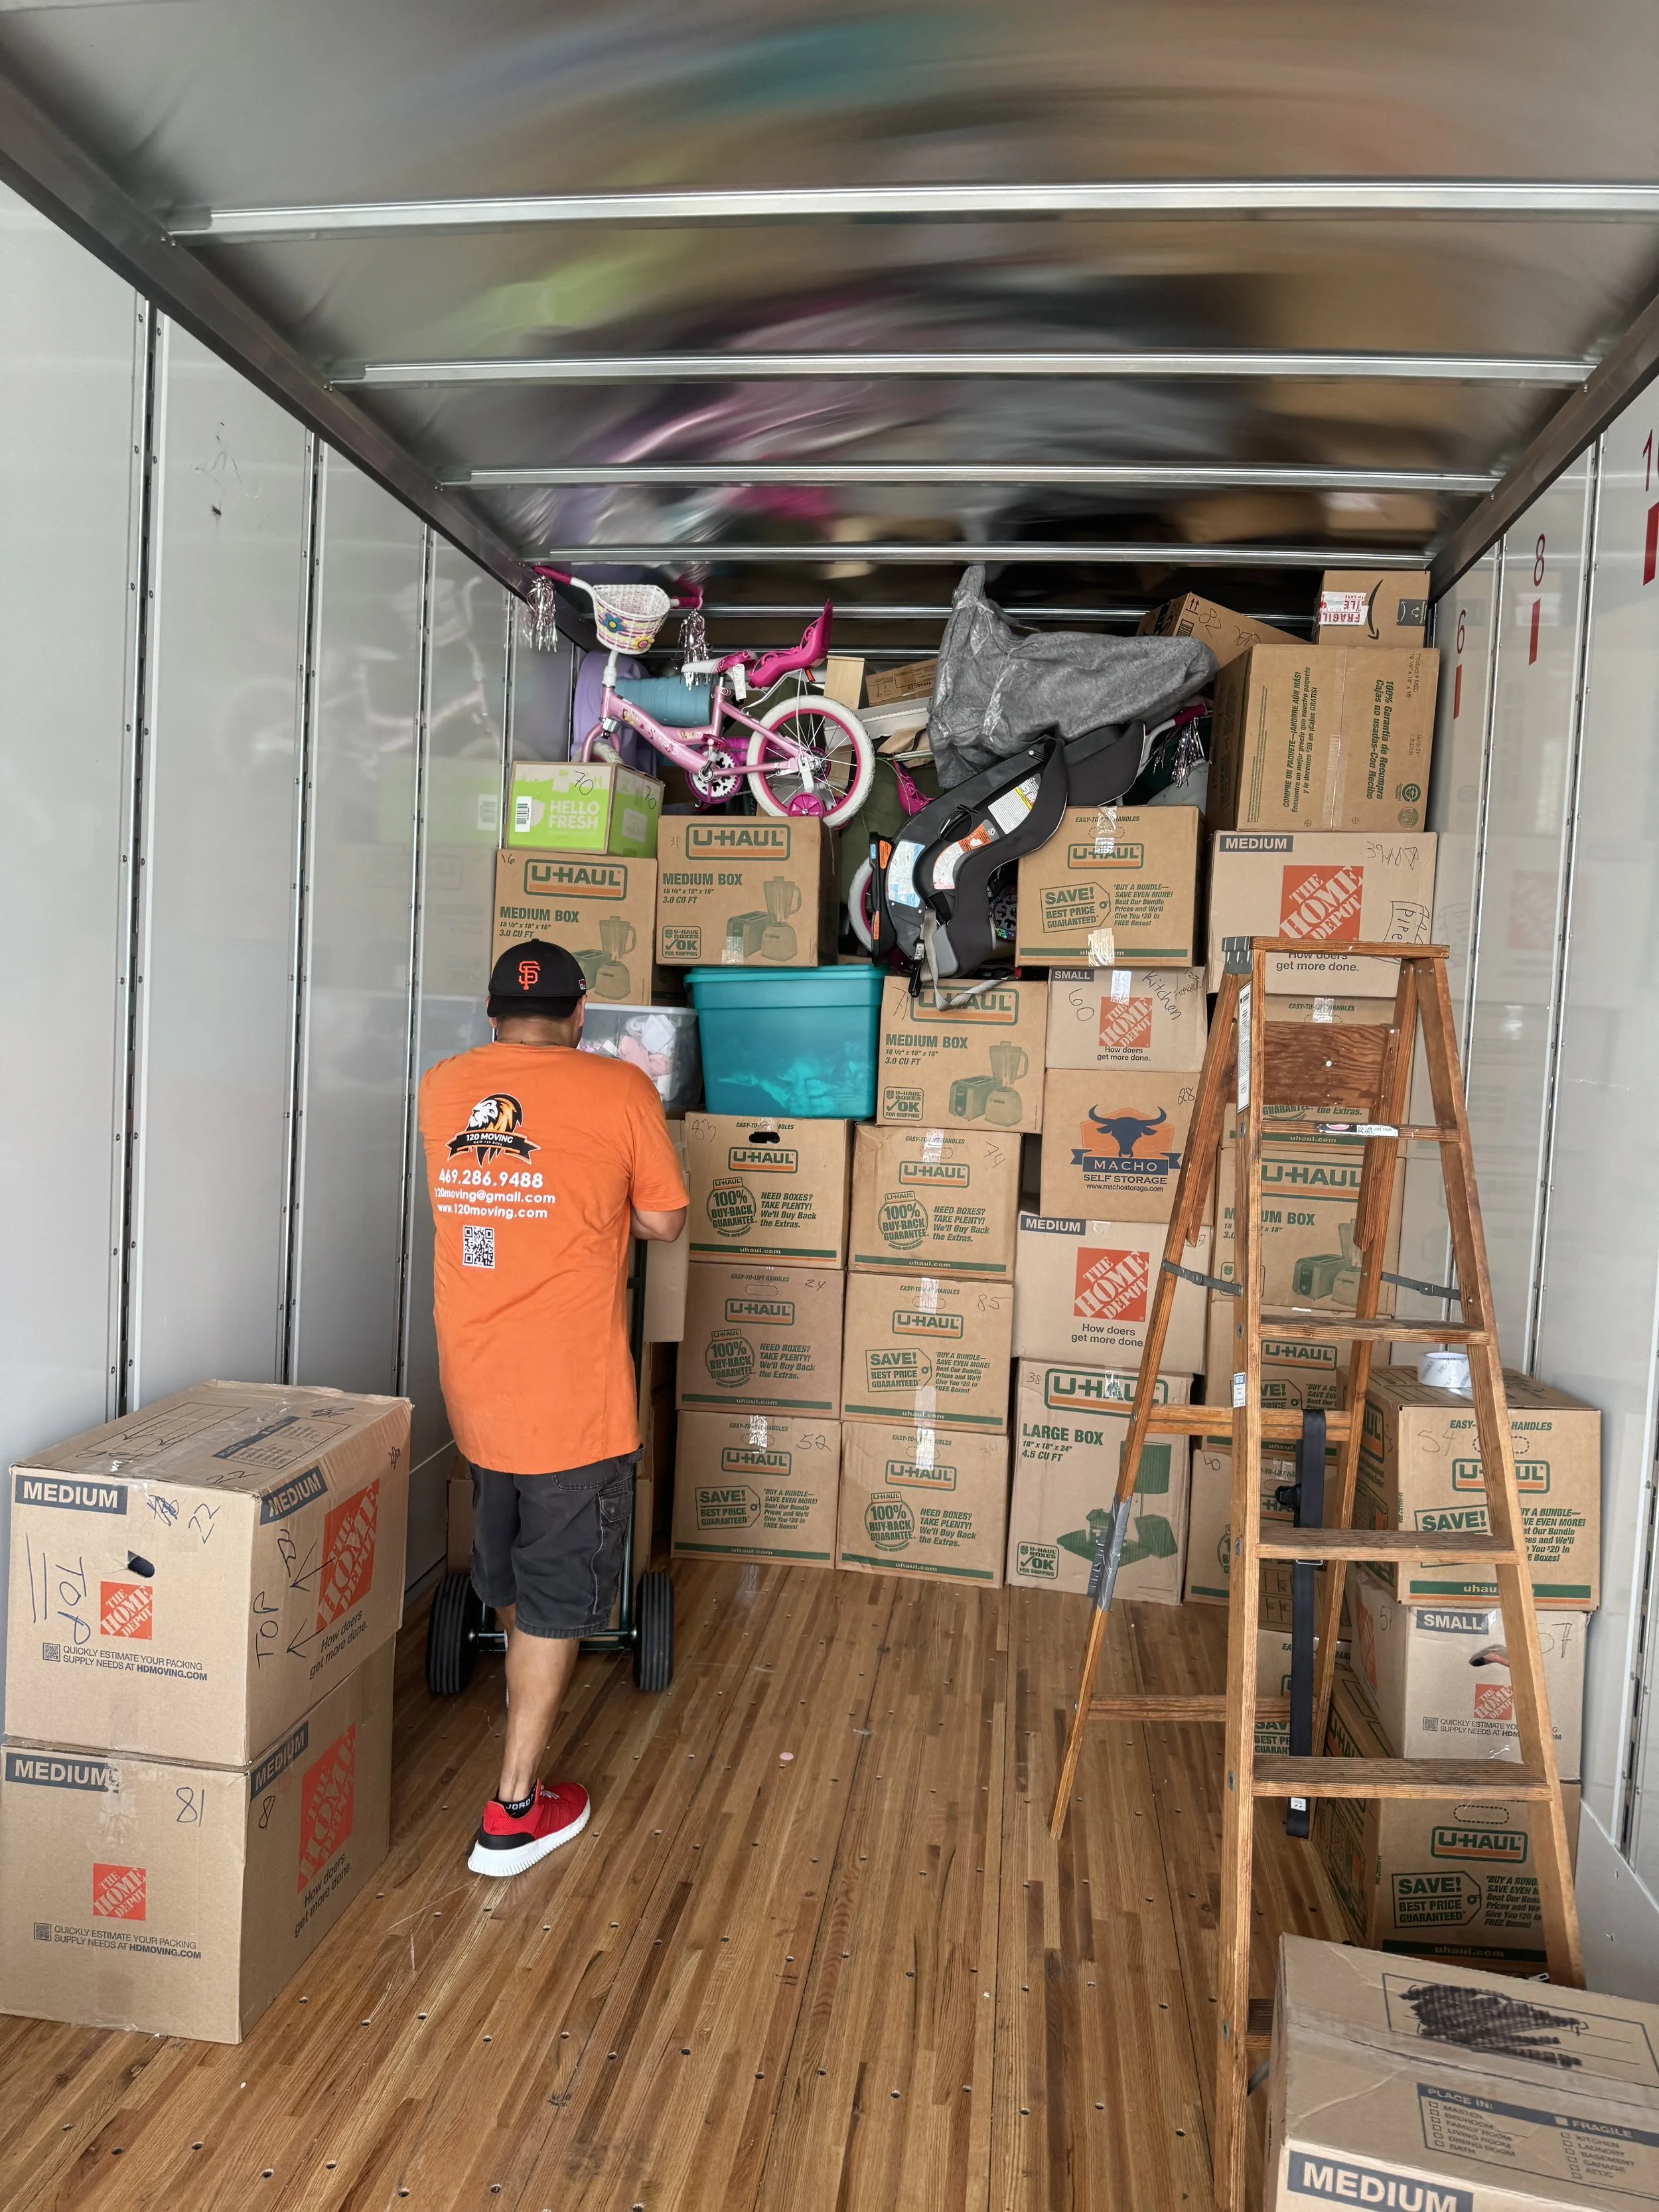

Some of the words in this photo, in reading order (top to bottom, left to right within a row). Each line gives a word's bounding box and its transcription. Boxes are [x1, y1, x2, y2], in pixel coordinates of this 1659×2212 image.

[1534, 534, 1546, 586] 8
[1318, 613, 1360, 623] FRAGILE
[1457, 610, 1466, 654] 6
[1374, 680, 1384, 703] Cajas
[1385, 680, 1394, 703] 100%
[1374, 705, 1380, 715] no
[1380, 744, 1388, 755] de
[575, 771, 593, 796] 70
[1366, 771, 1377, 800] Recibo
[1376, 757, 1388, 800] Recompra
[1283, 780, 1292, 808] COMPRE
[550, 800, 600, 816] HELLO
[549, 814, 599, 830] FRESH
[693, 830, 783, 846] U-HAUL
[1226, 838, 1287, 849] MEDIUM
[1073, 848, 1139, 859] U-HAUL
[532, 865, 620, 887] U-HAUL
[663, 873, 713, 885] MEDIUM
[718, 873, 743, 885] BOX
[1045, 887, 1094, 905] SAVE!
[1289, 873, 1325, 905] THE
[1279, 865, 1364, 939] HOME
[500, 907, 550, 921] MEDIUM
[555, 910, 579, 923] BOX
[1046, 909, 1068, 919] BEST
[1070, 907, 1095, 917] PRICE
[1310, 895, 1361, 940] DEPOT
[1054, 971, 1090, 980] SMALL
[1276, 962, 1294, 972] get
[1329, 962, 1359, 972] done.
[1142, 970, 1182, 1021] Kitchen
[1069, 988, 1094, 1021] 60
[1106, 1004, 1128, 1021] THE
[1100, 998, 1152, 1047] HOME
[1119, 1017, 1151, 1047] DEPOT
[886, 1034, 938, 1048] MEDIUM
[943, 1037, 968, 1049] BOX
[898, 1101, 920, 1112] OK
[481, 1133, 514, 1143] MOVING
[733, 1151, 794, 1164] U-HAUL
[1095, 1160, 1157, 1171] MACHO
[439, 1168, 543, 1188] 469.286.9488
[904, 1165, 966, 1179] U-HAUL
[434, 1187, 555, 1203] 120moving@gmail.com
[1086, 1183, 1163, 1192] www.machostorage.com
[713, 1189, 747, 1207] 100%
[437, 1203, 547, 1220] www.120moving.com
[711, 1205, 753, 1218] BUY-BACK
[1287, 1212, 1316, 1226] BOX
[1025, 1218, 1080, 1232] MEDIUM
[1082, 1256, 1114, 1284] THE
[1074, 1251, 1149, 1317] HOME
[1102, 1278, 1147, 1319] DEPOT
[730, 1303, 790, 1316] U-HAUL
[897, 1314, 959, 1329] U-HAUL
[1082, 1323, 1104, 1334] How
[1107, 1326, 1135, 1336] doers
[1071, 1335, 1087, 1344] get
[1090, 1336, 1116, 1345] more
[871, 1353, 916, 1365] SAVE!
[1265, 1344, 1333, 1362] U-HAUL
[1023, 1423, 1068, 1441] LARGE
[1074, 1430, 1104, 1445] BOX
[1512, 1421, 1552, 1431] HANDLES
[727, 1452, 787, 1467] U-HAUL
[1022, 1449, 1036, 1459] 4.5
[1038, 1451, 1049, 1460] CU
[1052, 1453, 1063, 1461] FT
[891, 1465, 952, 1481] U-HAUL
[23, 1481, 118, 1509] MEDIUM
[268, 1473, 321, 1517] MEDIUM
[700, 1490, 746, 1503] SAVE!
[1422, 1510, 1486, 1532] SAVE!
[106, 1587, 128, 1609] THE
[100, 1586, 153, 1636] HOME
[121, 1607, 152, 1637] DEPOT
[1423, 1613, 1482, 1631] SMALL
[64, 1646, 98, 1657] QUICKLY
[100, 1651, 139, 1662] ESTIMATE
[140, 1655, 165, 1666] YOUR
[167, 1659, 202, 1670] PACKING
[64, 1655, 94, 1666] SUPPLY
[97, 1660, 123, 1670] NEEDS
[137, 1664, 208, 1681] HDMOVING.COM
[15, 1759, 108, 1786] MEDIUM
[1439, 1832, 1522, 1852] U-HAUL
[1398, 1877, 1462, 1895] SAVE!
[1400, 1901, 1427, 1913] BEST
[1429, 1899, 1462, 1911] PRICE
[1427, 2088, 1472, 2104] PLACE
[1573, 2120, 1634, 2138] FRAGILE
[1303, 2161, 1459, 2212] MEDIUM
